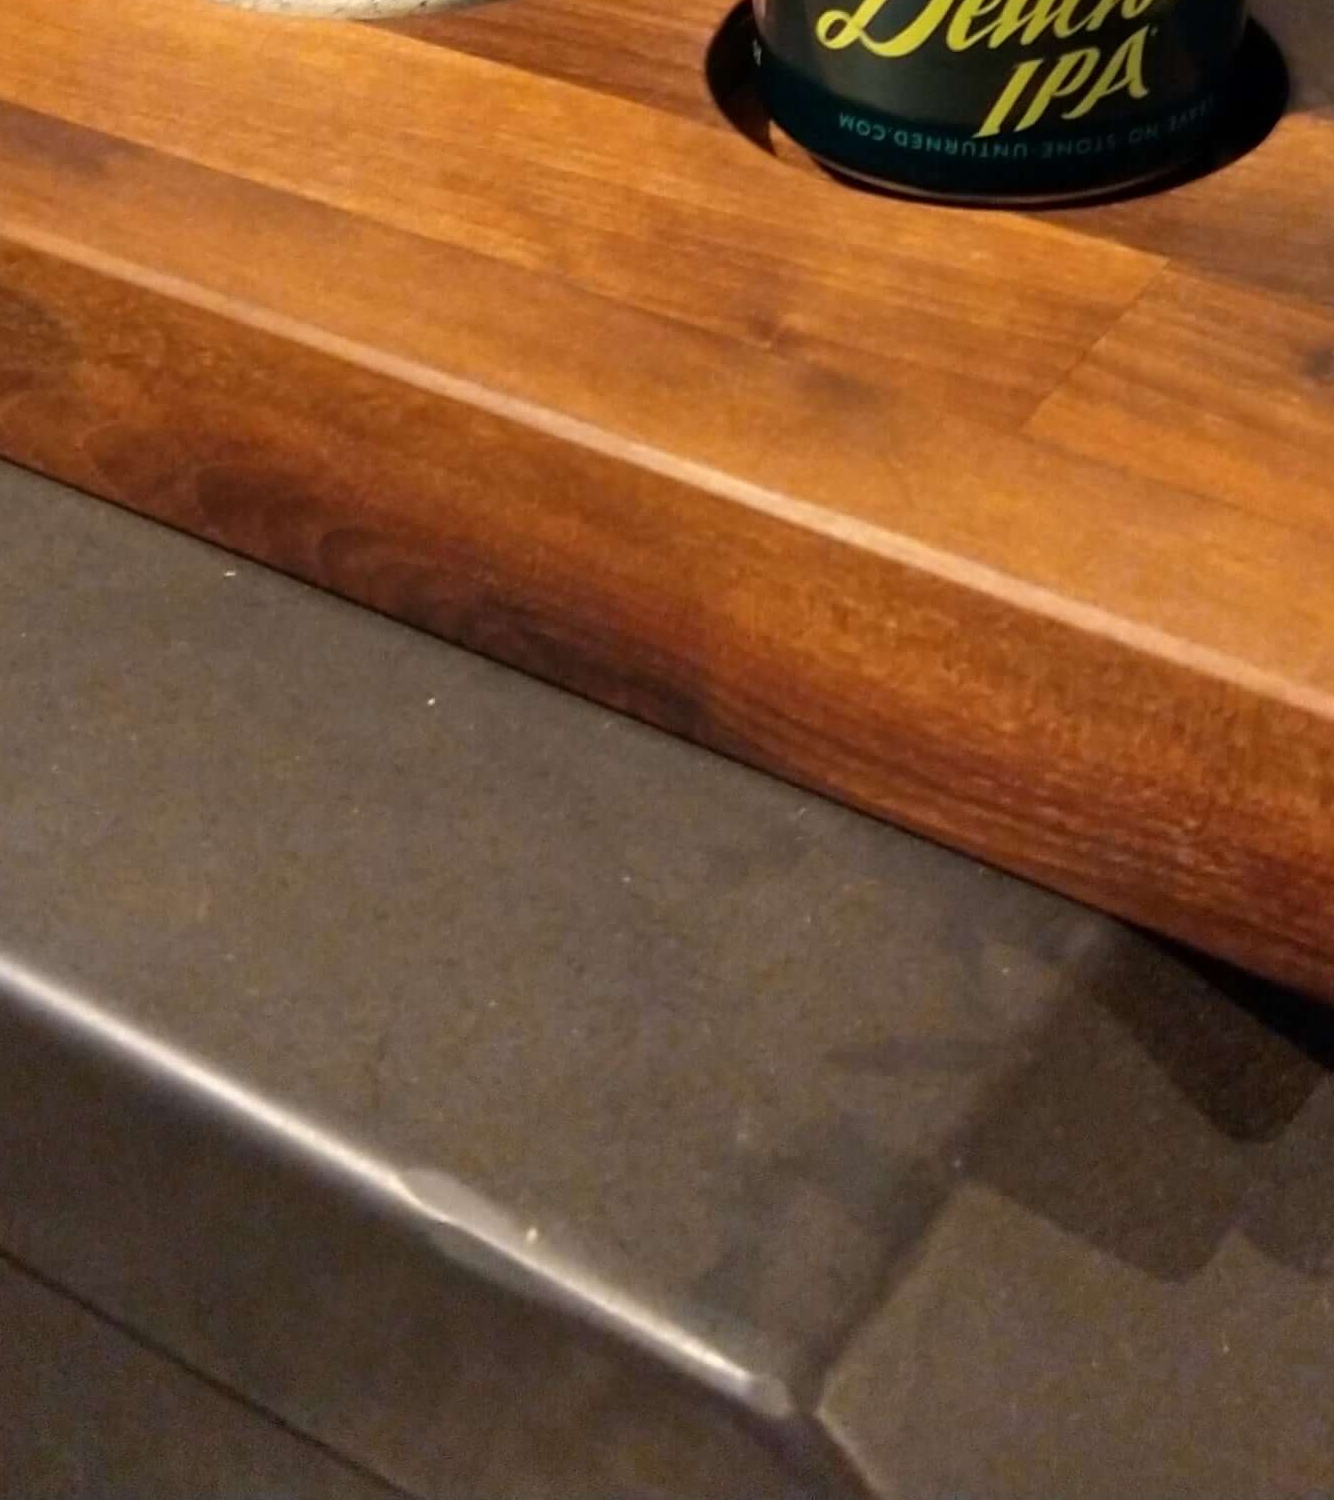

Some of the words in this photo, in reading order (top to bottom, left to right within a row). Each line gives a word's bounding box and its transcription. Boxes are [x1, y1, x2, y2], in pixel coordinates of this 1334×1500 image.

[971, 25, 1149, 139] IPA
[837, 110, 1029, 158] UNTURNED.COM
[1039, 133, 1117, 160] STONE
